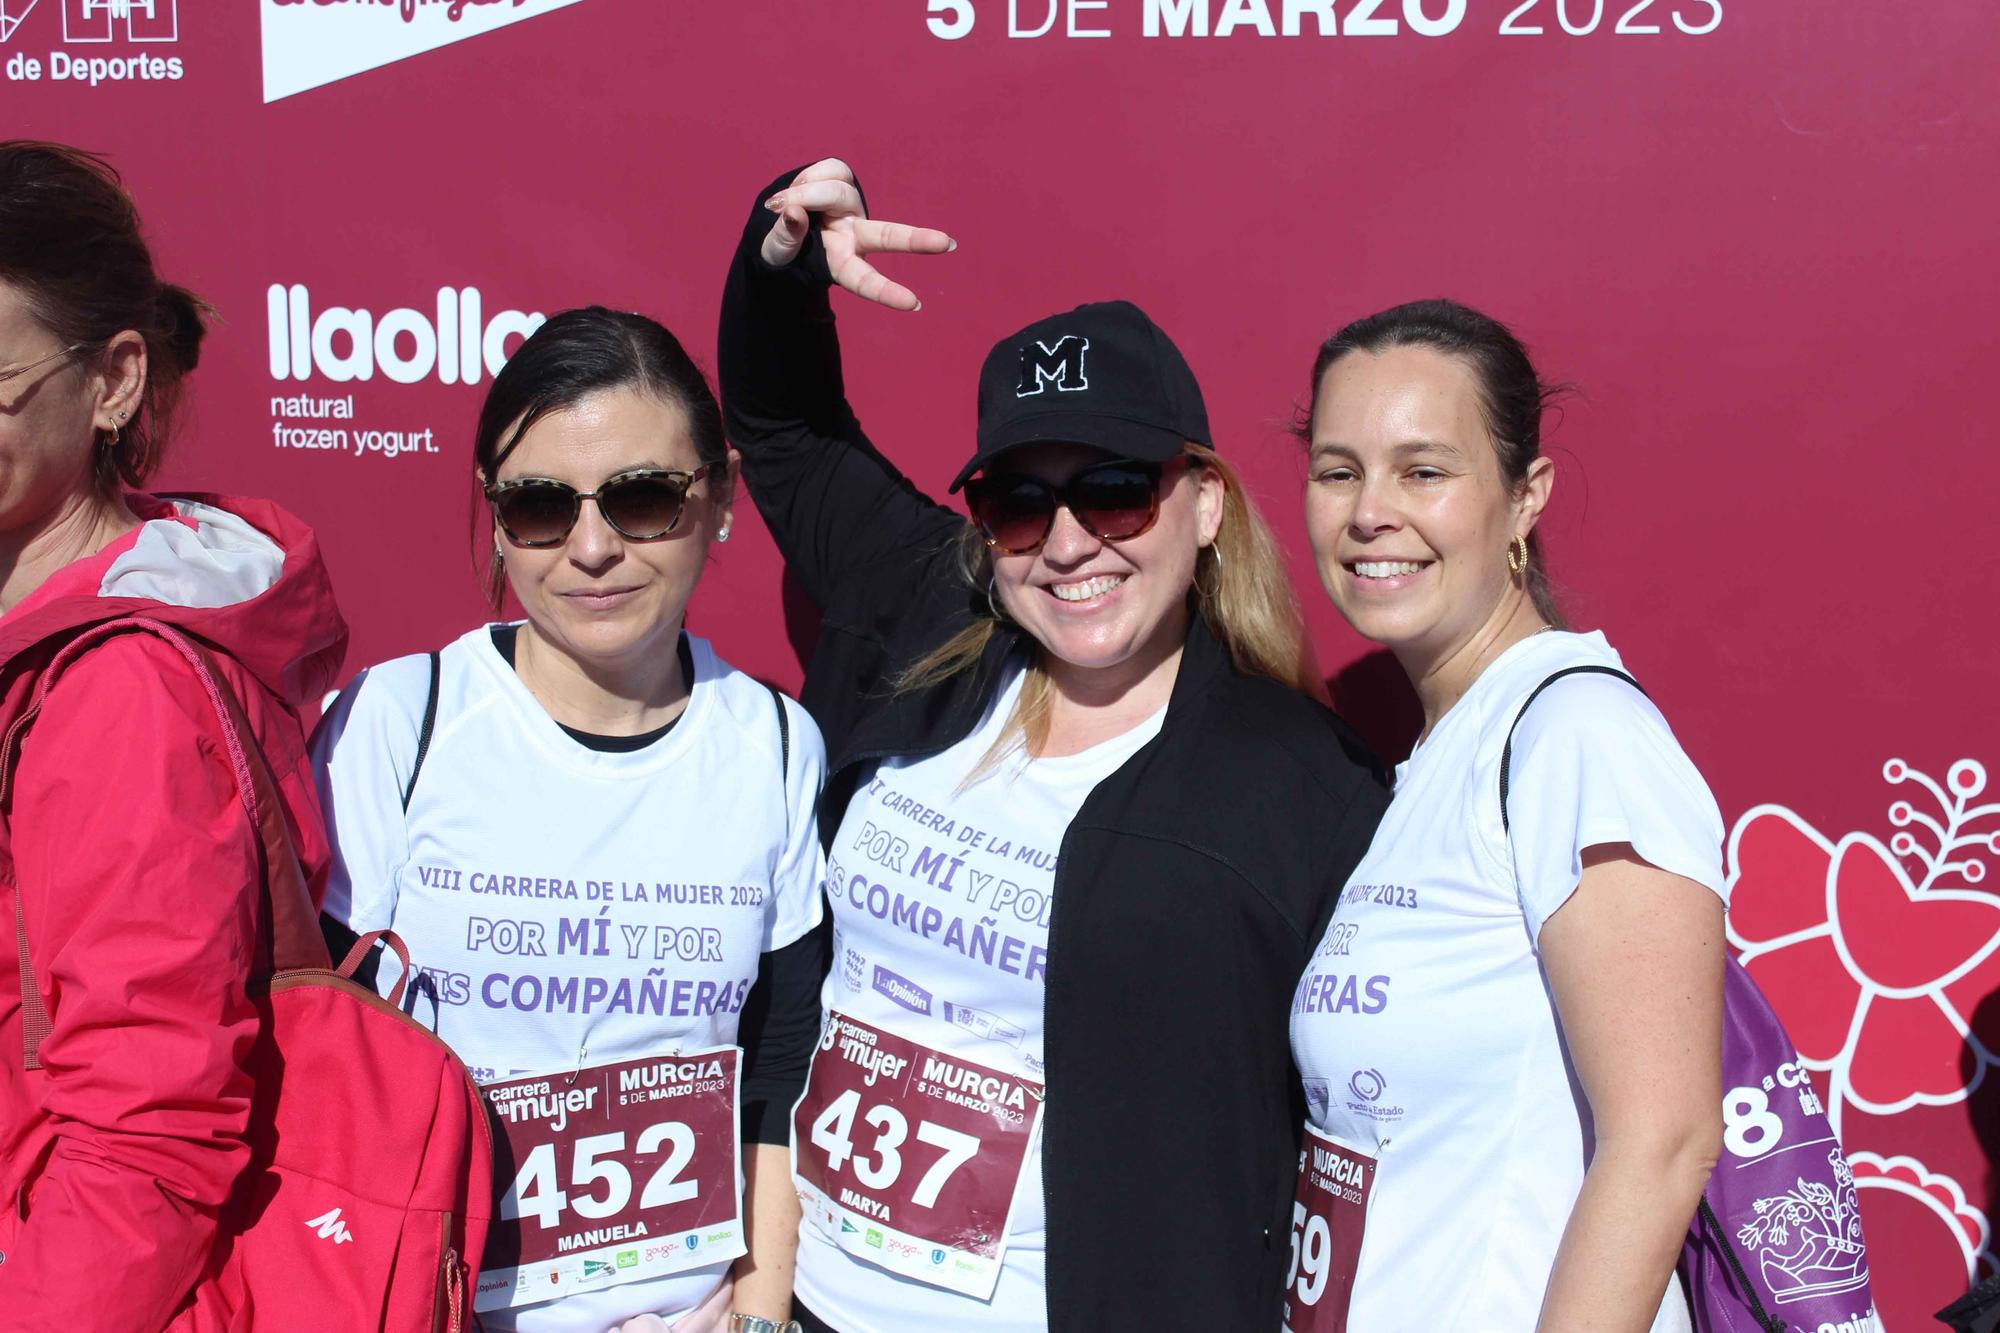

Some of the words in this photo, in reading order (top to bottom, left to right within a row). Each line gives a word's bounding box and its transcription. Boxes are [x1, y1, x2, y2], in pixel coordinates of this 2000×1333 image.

[926, 0, 976, 41] 5
[1007, 0, 1112, 38] DE
[1142, 0, 1467, 38] MARZO
[1498, 0, 1723, 36] 2023
[6, 52, 42, 81] de
[50, 51, 184, 87] Deportes
[1016, 335, 1090, 398] M
[271, 393, 353, 419] natural
[273, 422, 348, 450] frozen
[353, 428, 440, 458] yogurt.
[881, 791, 956, 838] CARRERA
[957, 826, 987, 848] DE
[985, 836, 1012, 857] LA
[852, 820, 909, 873] POR
[909, 846, 971, 893] MÍ
[966, 869, 994, 903] Y
[418, 865, 462, 891] VIII
[469, 872, 579, 900] CARRERA
[586, 880, 614, 901] DE
[622, 882, 648, 902] LA
[656, 883, 724, 905] MUJER
[730, 886, 763, 906] 2023
[1373, 884, 1418, 909] 2023
[467, 916, 547, 957] POR
[557, 905, 611, 956] MÍ
[620, 924, 648, 959] Y
[654, 925, 723, 962] POR
[481, 967, 749, 1017] COMPAÑERAS
[841, 1022, 877, 1046] carrera
[620, 1060, 724, 1092] MURCIA
[843, 1039, 908, 1087] mujer
[922, 1057, 1025, 1110] MURCIA
[489, 1081, 550, 1102] carrera
[509, 1086, 598, 1132] mujer
[619, 1094, 628, 1106] 5
[630, 1091, 647, 1104] DE
[649, 1083, 693, 1101] MARZO
[695, 1079, 725, 1094] 2023
[917, 1081, 927, 1093] 5
[927, 1085, 944, 1099] DE
[945, 1090, 990, 1113] MARZO
[991, 1105, 1024, 1124] 2023
[811, 1088, 981, 1209] 437
[1313, 1145, 1363, 1189] MURCIA
[500, 1121, 699, 1229] 452
[840, 1188, 891, 1222] MARYA
[1342, 1187, 1362, 1205] 2023
[558, 1221, 648, 1252] MANUELA
